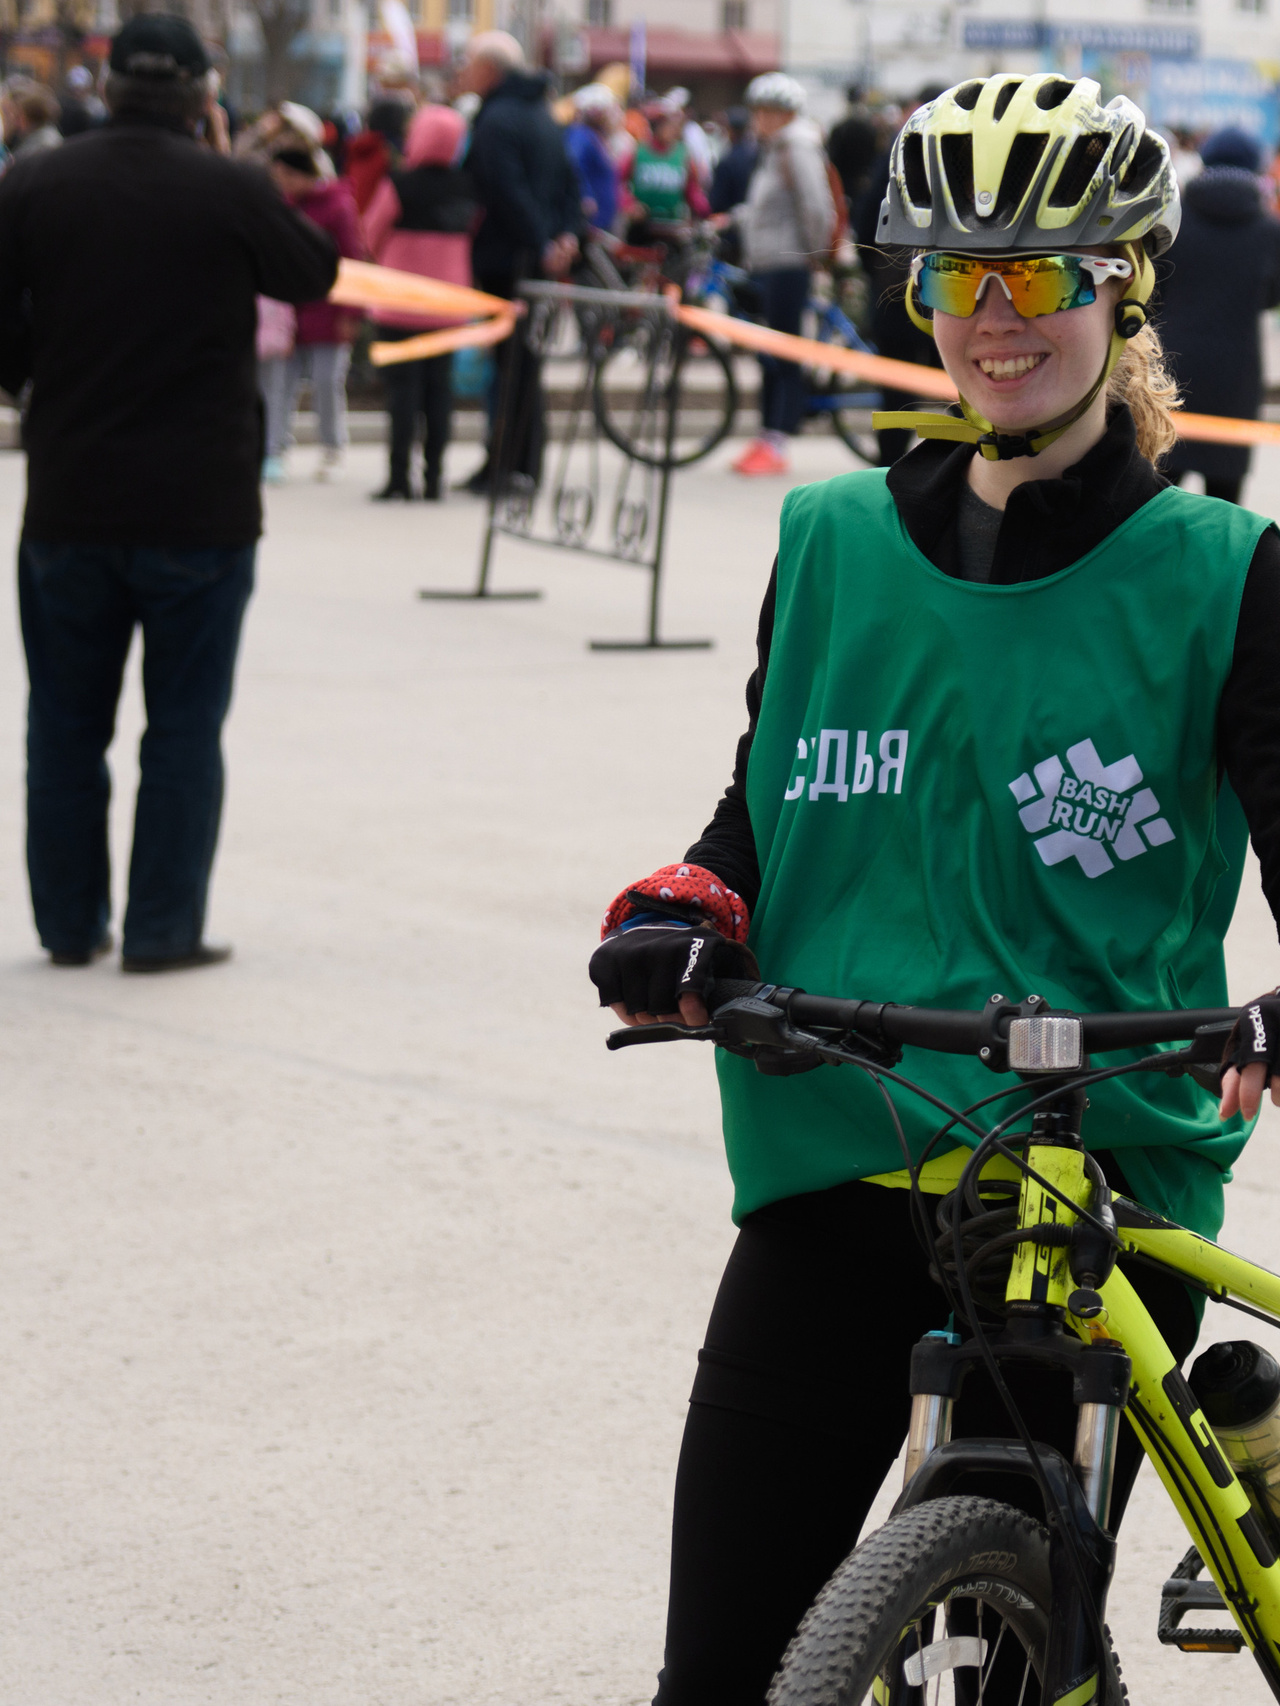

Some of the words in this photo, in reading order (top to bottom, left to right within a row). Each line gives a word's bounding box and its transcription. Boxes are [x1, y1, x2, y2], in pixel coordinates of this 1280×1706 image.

[784, 728, 909, 802] СДЬЯ
[1060, 776, 1130, 816] BASH
[1052, 800, 1122, 841] RUN
